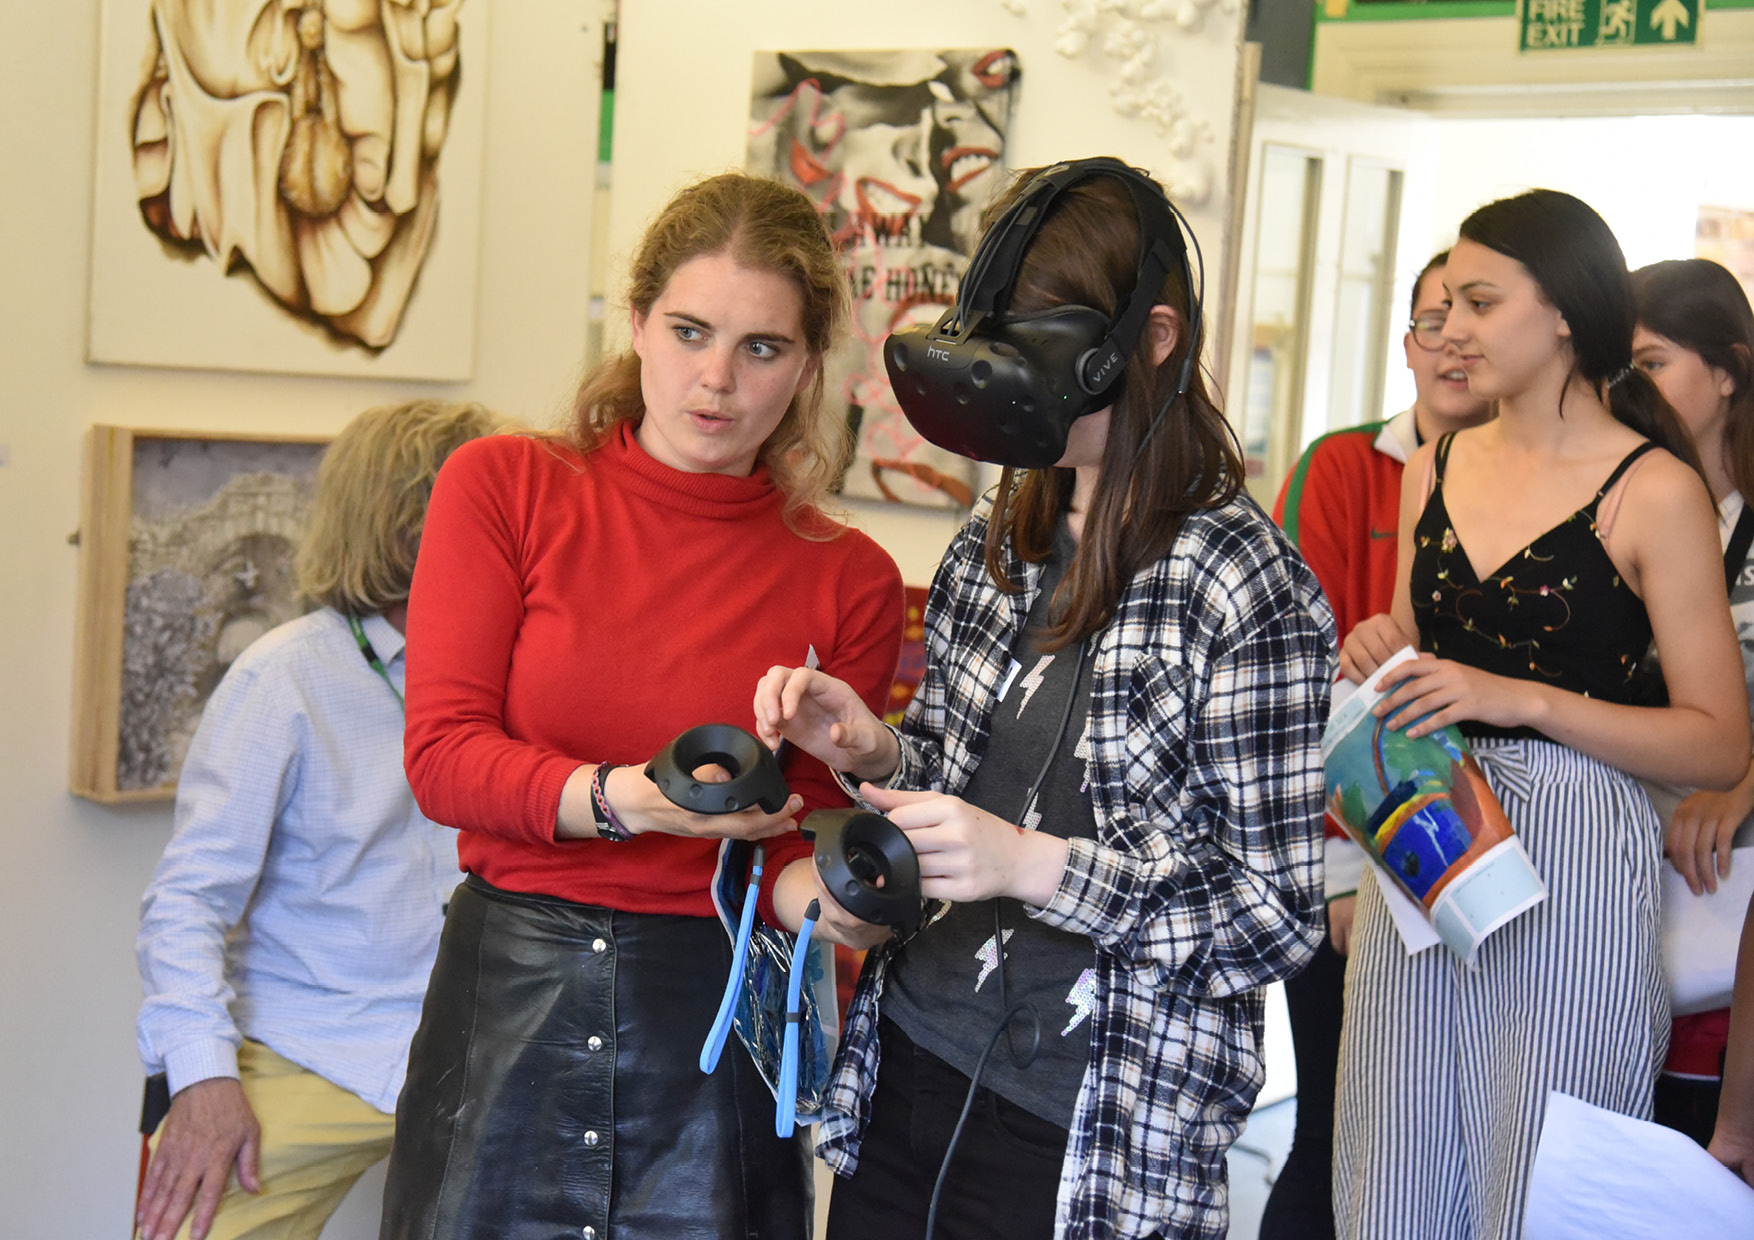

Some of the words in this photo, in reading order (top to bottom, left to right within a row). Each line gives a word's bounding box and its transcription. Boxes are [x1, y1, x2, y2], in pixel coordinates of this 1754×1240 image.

[1528, 0, 1585, 20] FIRE
[1526, 22, 1585, 47] EXIT
[886, 263, 964, 301] HONE
[1093, 352, 1118, 382] VIVE
